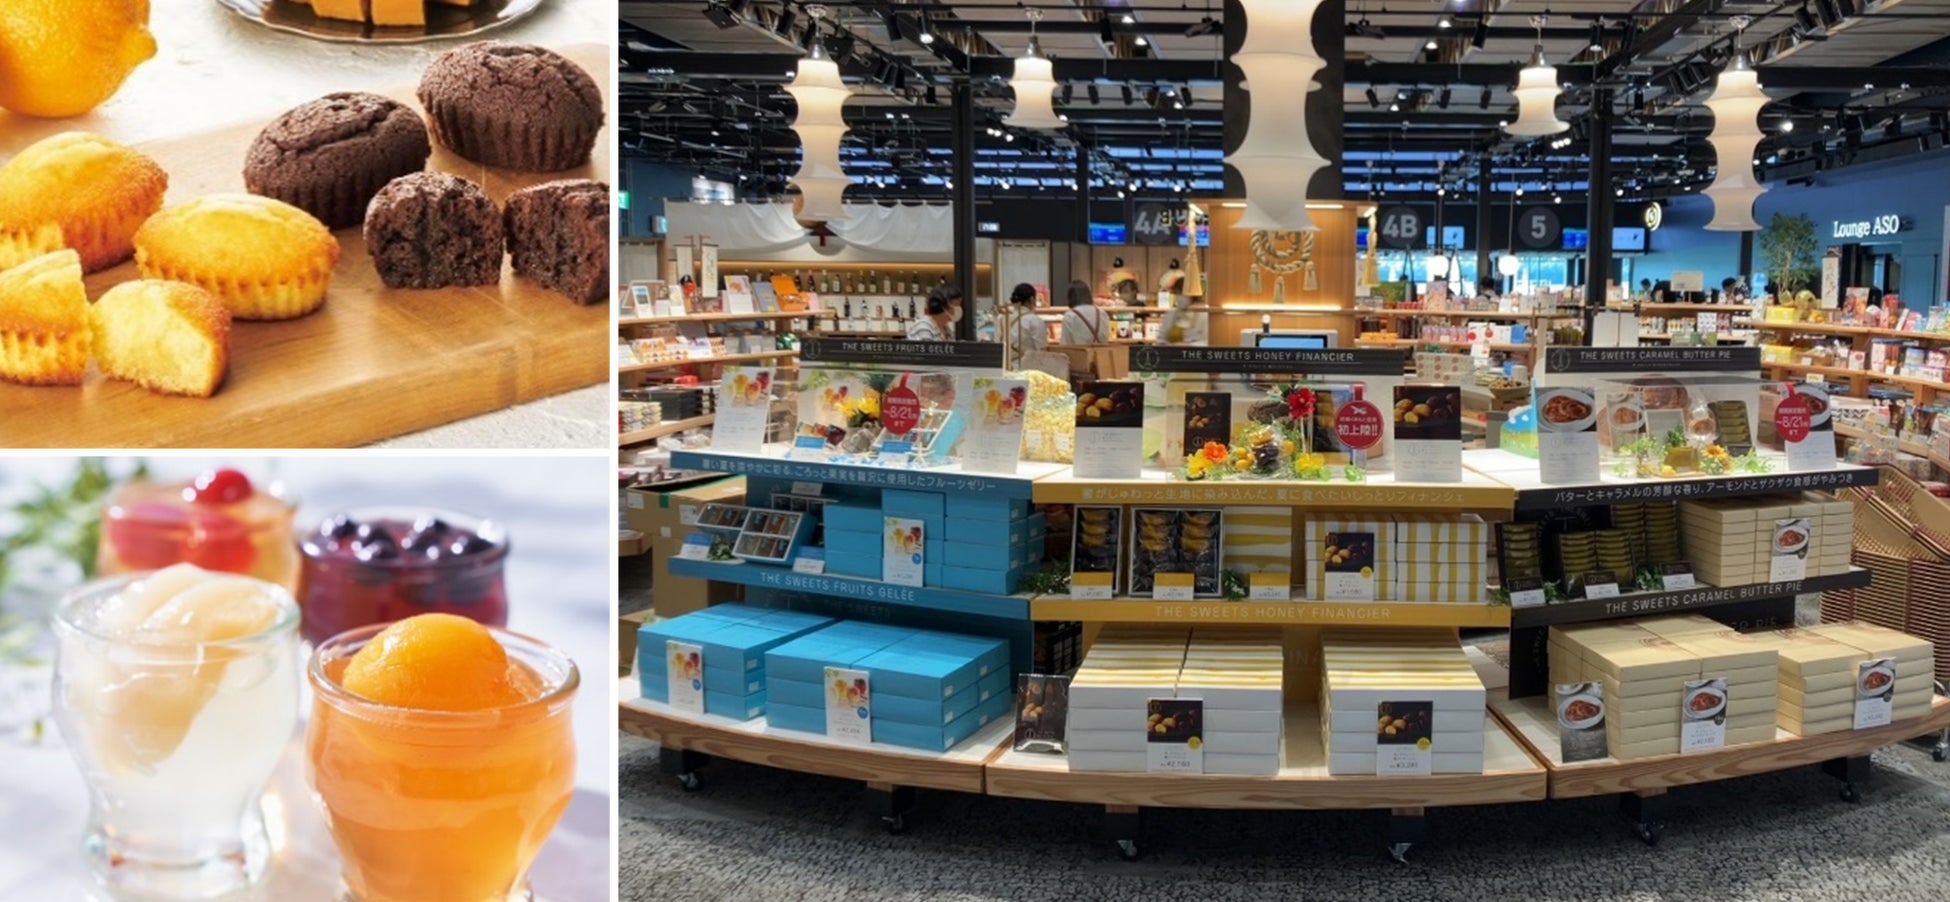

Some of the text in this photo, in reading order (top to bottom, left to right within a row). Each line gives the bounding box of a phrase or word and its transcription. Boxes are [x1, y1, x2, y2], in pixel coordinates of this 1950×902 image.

[1135, 211, 1170, 235] 4A
[1382, 214, 1418, 238] 4B
[1531, 215, 1546, 239] 5
[1832, 214, 1900, 238] Lounge ASO
[842, 342, 857, 350] THE
[861, 343, 893, 352] SWEETS
[896, 344, 925, 353] FRUITS
[1182, 350, 1354, 362] THE SWEETS HONEY FINANCIER
[1580, 350, 1731, 360] THE SWEETS CARAMEL BUTTER PIE
[760, 572, 915, 601] THE SWEETS FRUITS GELÉE
[1605, 581, 1802, 614] THE SWEETS CARAMEL BUTTER PIE
[1156, 606, 1391, 619] THE SWEETS HONEY FINANCIER
